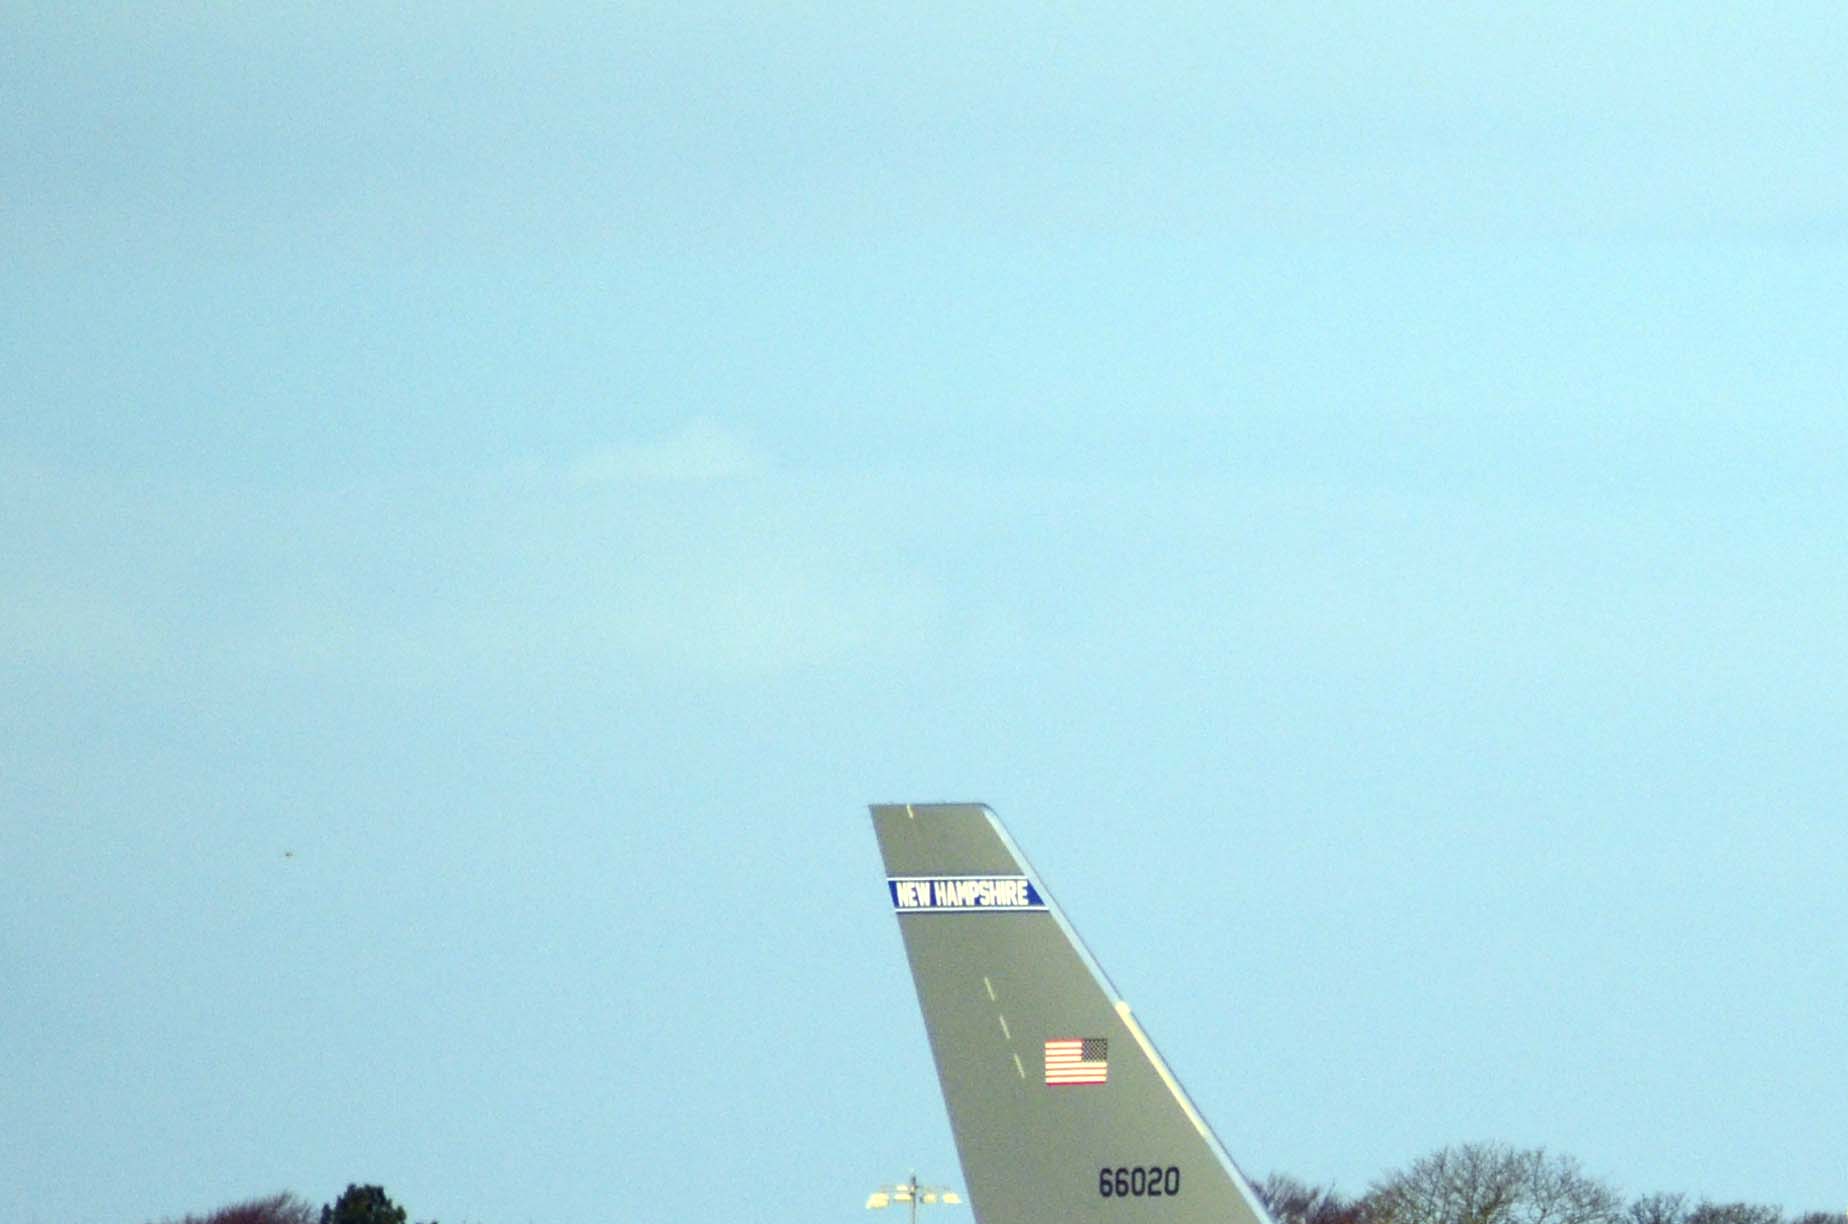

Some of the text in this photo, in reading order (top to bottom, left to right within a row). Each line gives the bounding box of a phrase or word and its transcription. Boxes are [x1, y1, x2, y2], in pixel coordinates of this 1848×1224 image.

[896, 880, 1029, 907] NEW HAMPSHIRE
[1099, 1166, 1180, 1197] 66020
